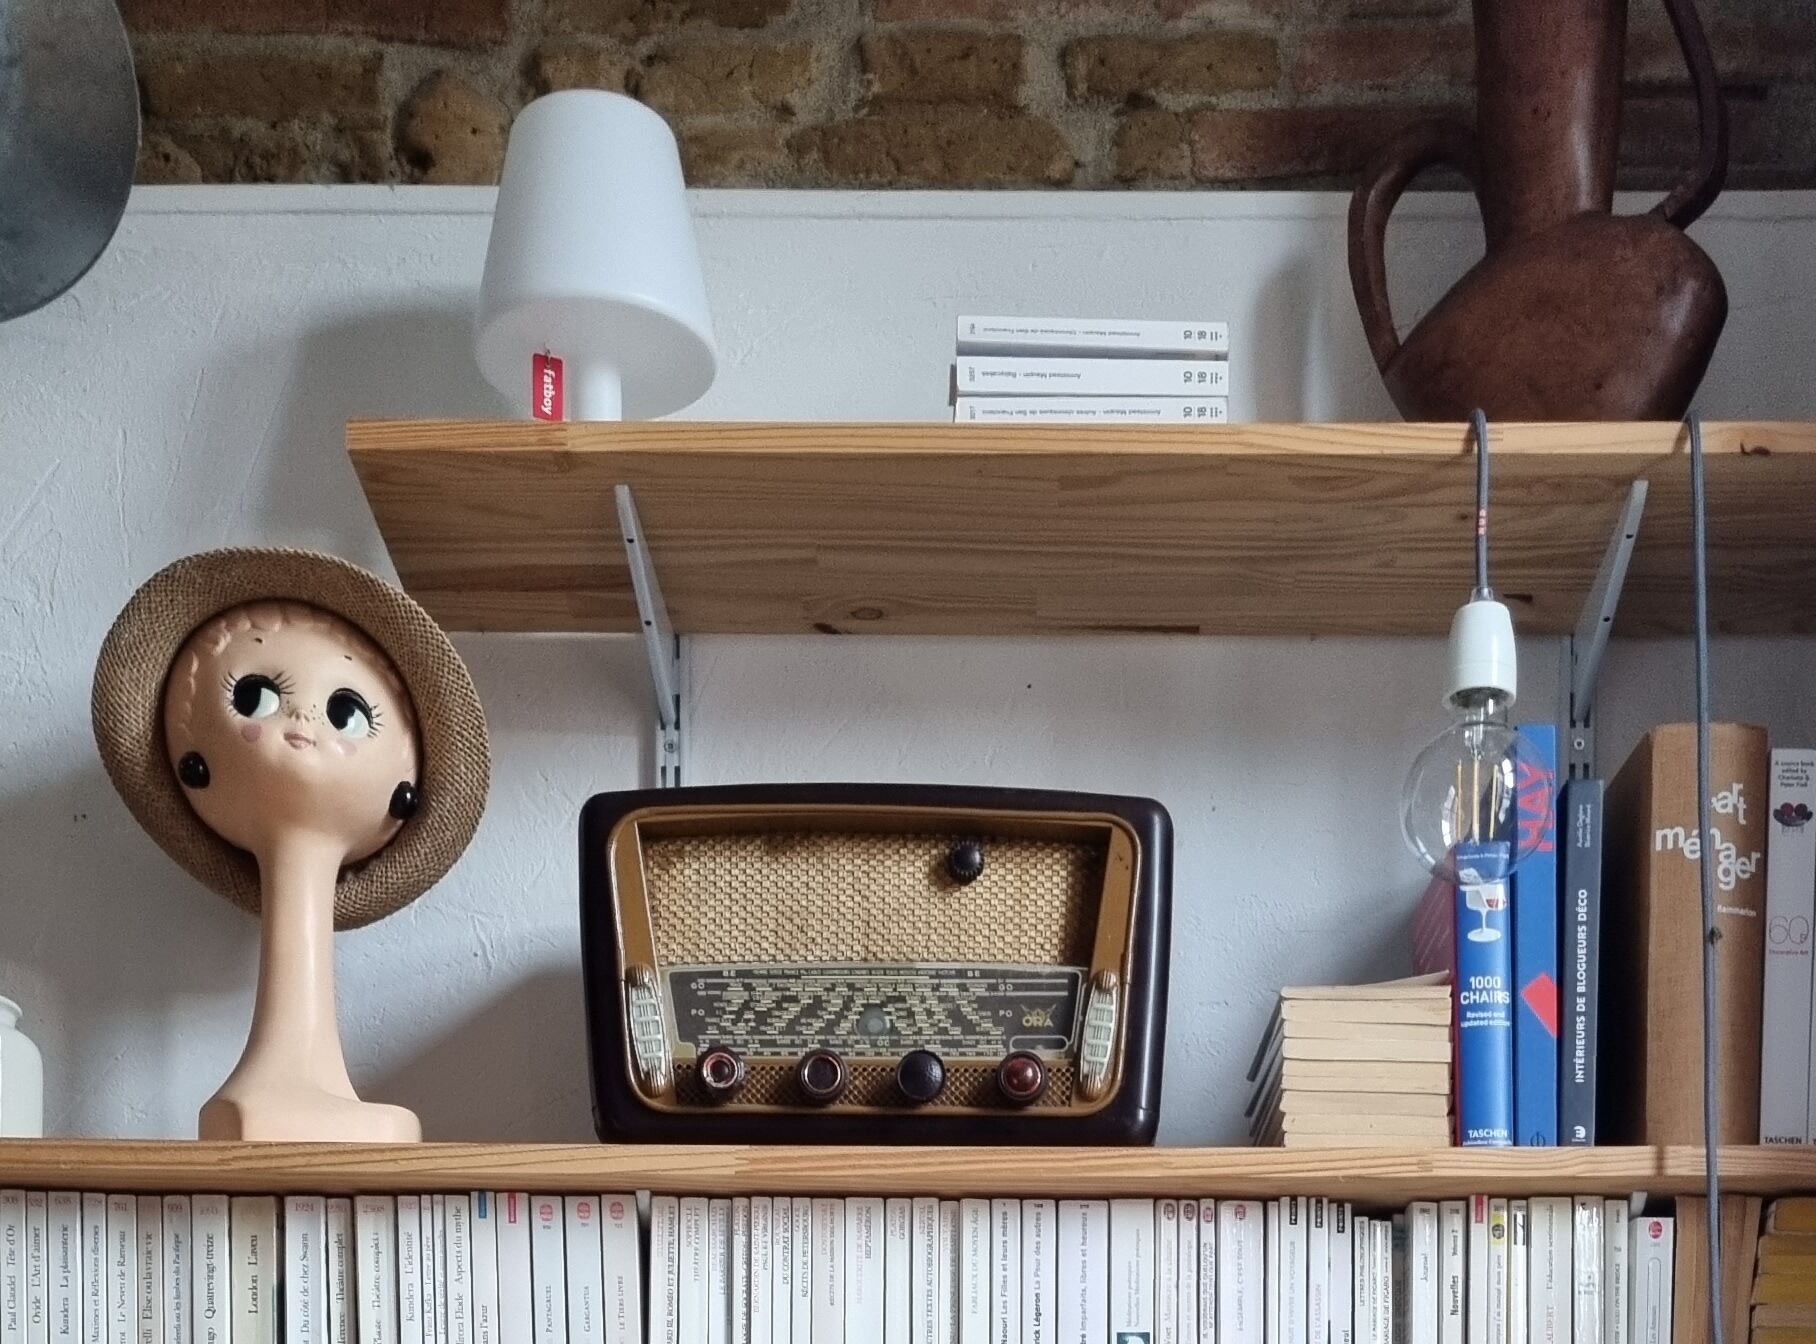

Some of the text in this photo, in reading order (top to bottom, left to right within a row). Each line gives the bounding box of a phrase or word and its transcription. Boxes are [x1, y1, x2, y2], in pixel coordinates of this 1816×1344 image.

[1183, 330, 1193, 340] 10
[1197, 330, 1207, 340] 18
[1183, 371, 1193, 383] 10
[1197, 371, 1207, 383] 18
[541, 369, 556, 416] fatboy
[1183, 406, 1193, 418] 10
[1197, 406, 1207, 418] 18
[1519, 762, 1554, 852] HAY
[1574, 889, 1588, 921] DÉCO
[1576, 924, 1588, 992] BLOGUEURS
[1469, 976, 1501, 990] 1000
[1460, 990, 1510, 1005] CHAIRS
[1576, 996, 1587, 1012] DE
[1022, 1018, 1054, 1027] ORA
[1467, 1128, 1508, 1138] TASCHEN
[1764, 1136, 1802, 1144] TASCHEN
[452, 1206, 464, 1233] mythe
[117, 1230, 126, 1266] Rameau
[300, 1233, 309, 1261] Swann
[453, 1236, 462, 1248] du
[1081, 1248, 1087, 1257] et
[31, 1226, 41, 1324] Ovide L'Art d'aimer
[117, 1270, 126, 1280] de
[204, 1233, 216, 1319] Quatrevingt-treize
[248, 1235, 258, 1314] London L'aveu
[300, 1264, 309, 1283] chez
[454, 1250, 465, 1284] Aspects
[1001, 1264, 1007, 1272] et
[1420, 1253, 1428, 1282] Journal
[6, 1225, 17, 1331] Paul Claudel Tête d'Or
[59, 1225, 71, 1335] Kundera La plaisanterie
[403, 1232, 414, 1322] Kundera L'identité
[783, 1274, 790, 1284] DU
[1034, 1281, 1040, 1290] La
[117, 1282, 126, 1309] Neveu
[300, 1286, 309, 1296] de
[1450, 1275, 1458, 1316] Nouvelles
[299, 1299, 310, 1317] côté
[666, 1288, 674, 1316] ROMÉO
[1033, 1292, 1042, 1326] Légeron
[1080, 1286, 1088, 1331] Imparfaits,
[1384, 1305, 1389, 1313] DE
[117, 1312, 126, 1322] Le
[480, 1304, 488, 1328] l'azur
[300, 1320, 310, 1333] Du
